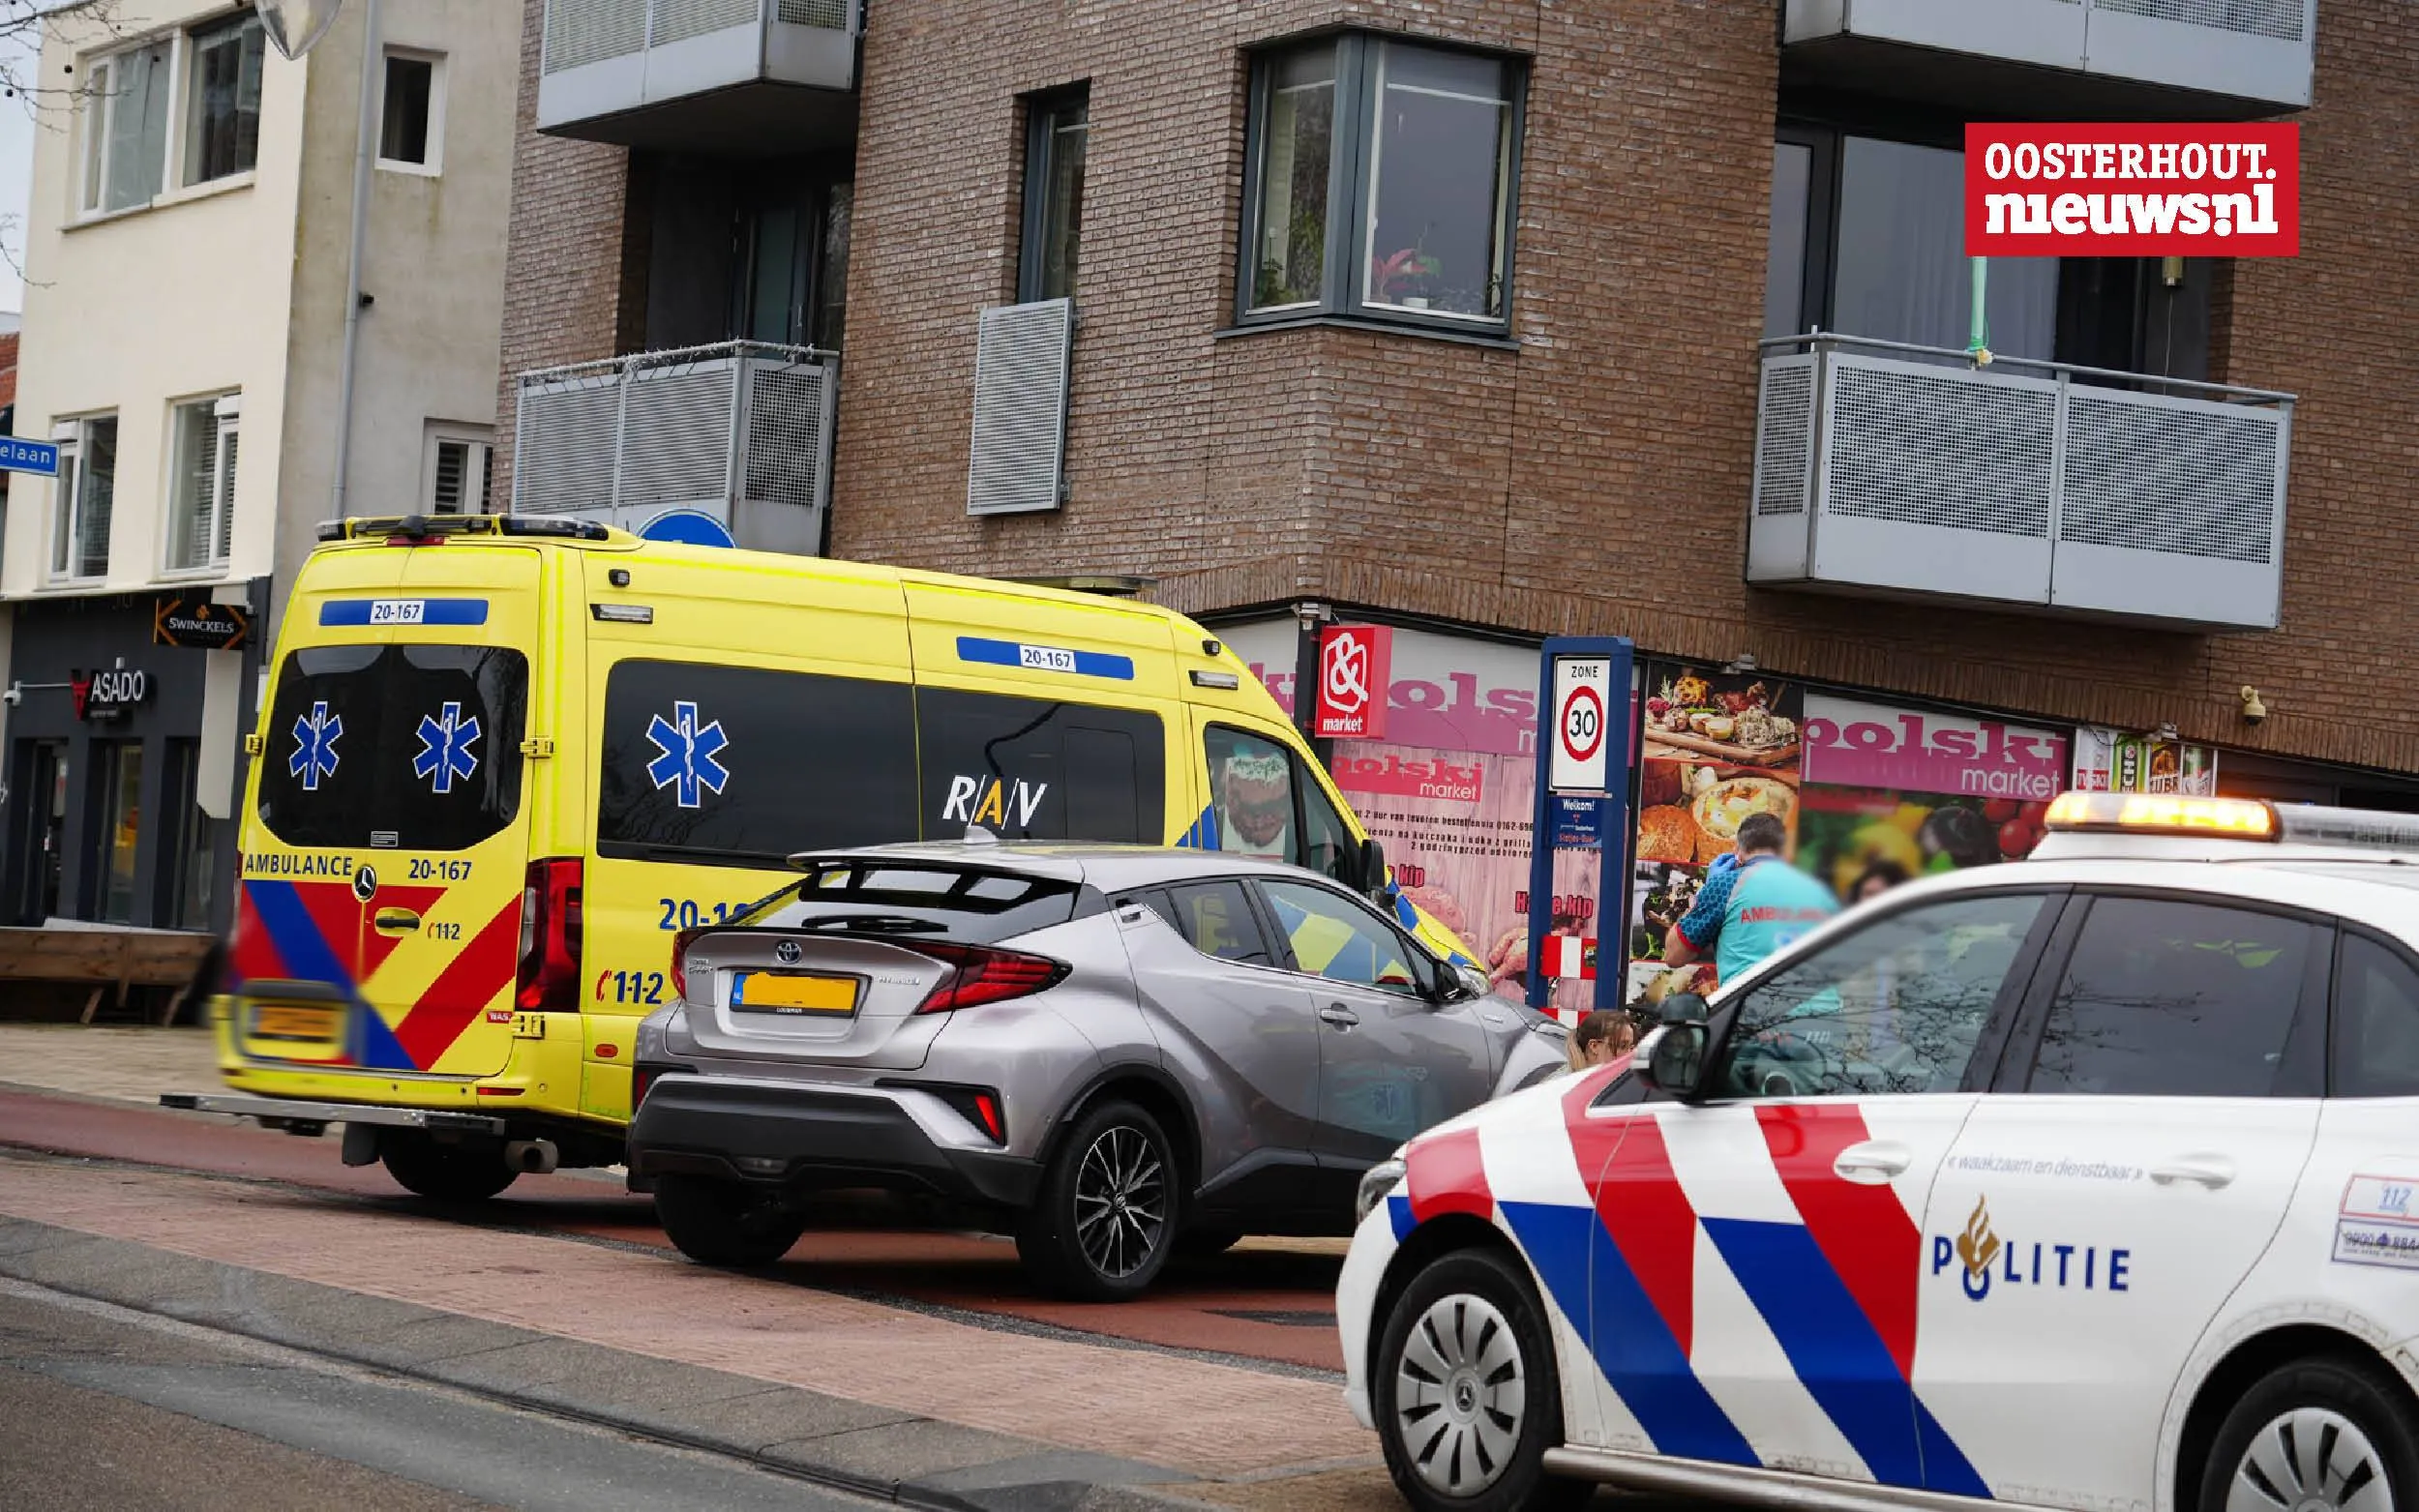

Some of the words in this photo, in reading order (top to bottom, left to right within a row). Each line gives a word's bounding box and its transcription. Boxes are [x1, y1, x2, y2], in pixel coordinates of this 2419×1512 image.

[374, 605, 420, 619] 20-167
[1025, 649, 1070, 667] 20-167
[1571, 666, 1598, 678] ZONE
[90, 670, 144, 702] ASADO
[1389, 672, 1536, 720] ols
[1323, 713, 1363, 732] market
[1568, 710, 1597, 737] 30
[1803, 714, 2068, 774] polski
[1419, 783, 1477, 800] market
[1961, 766, 2060, 797] market
[245, 854, 353, 875] AMBULANCE
[409, 859, 472, 880] 20-167
[1399, 864, 1424, 888] kip
[659, 898, 750, 931] 20-1
[1568, 895, 1594, 918] kip
[1958, 1153, 2032, 1173] waakzaam
[1932, 1235, 2130, 1301] POLITIE
